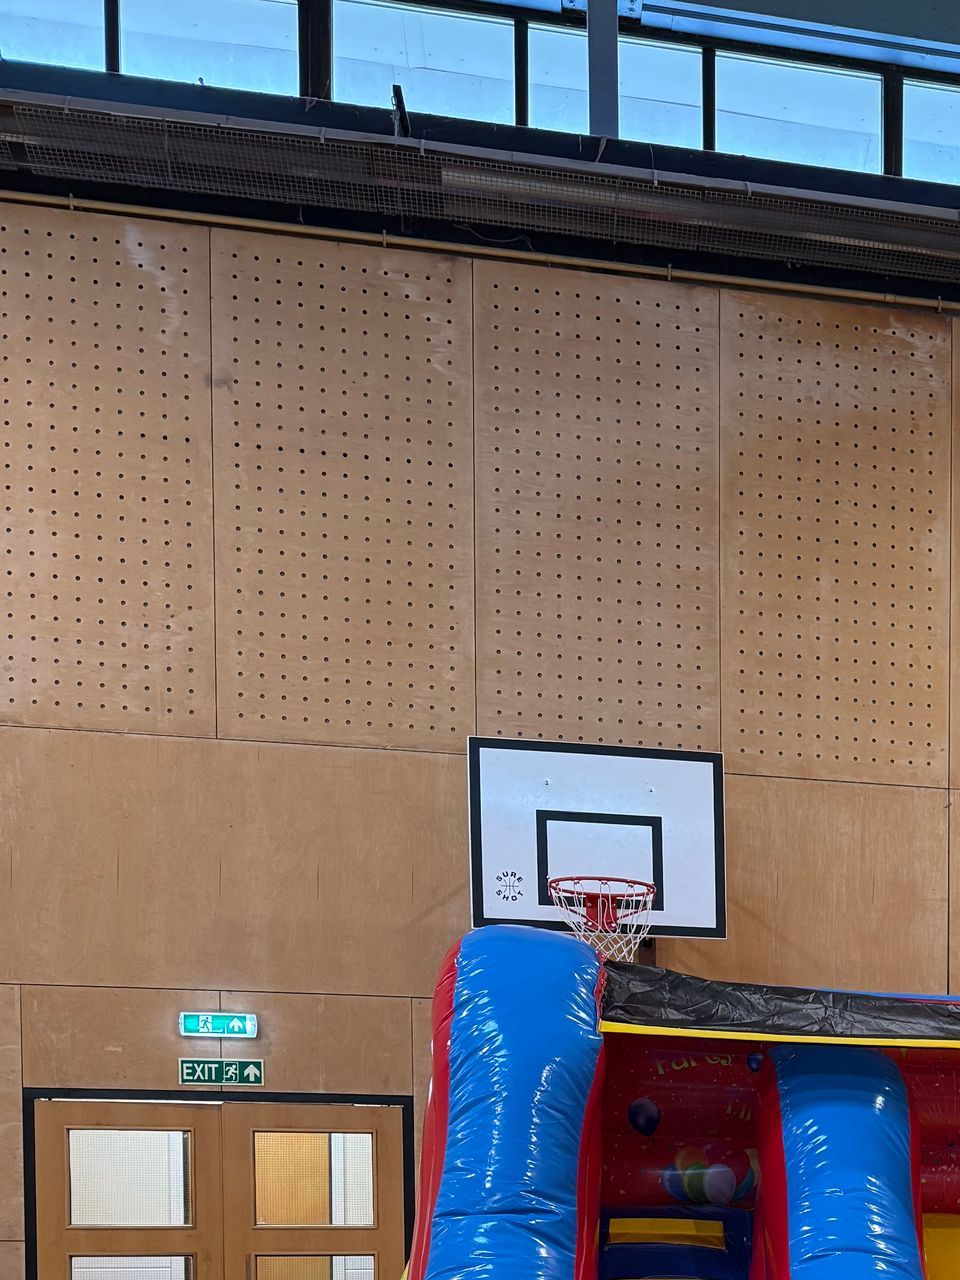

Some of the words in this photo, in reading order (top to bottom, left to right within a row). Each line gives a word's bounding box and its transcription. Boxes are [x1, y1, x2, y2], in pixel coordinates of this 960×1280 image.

[496, 871, 523, 882] SURE
[496, 889, 523, 901] SHOT
[183, 1063, 218, 1080] EXIT
